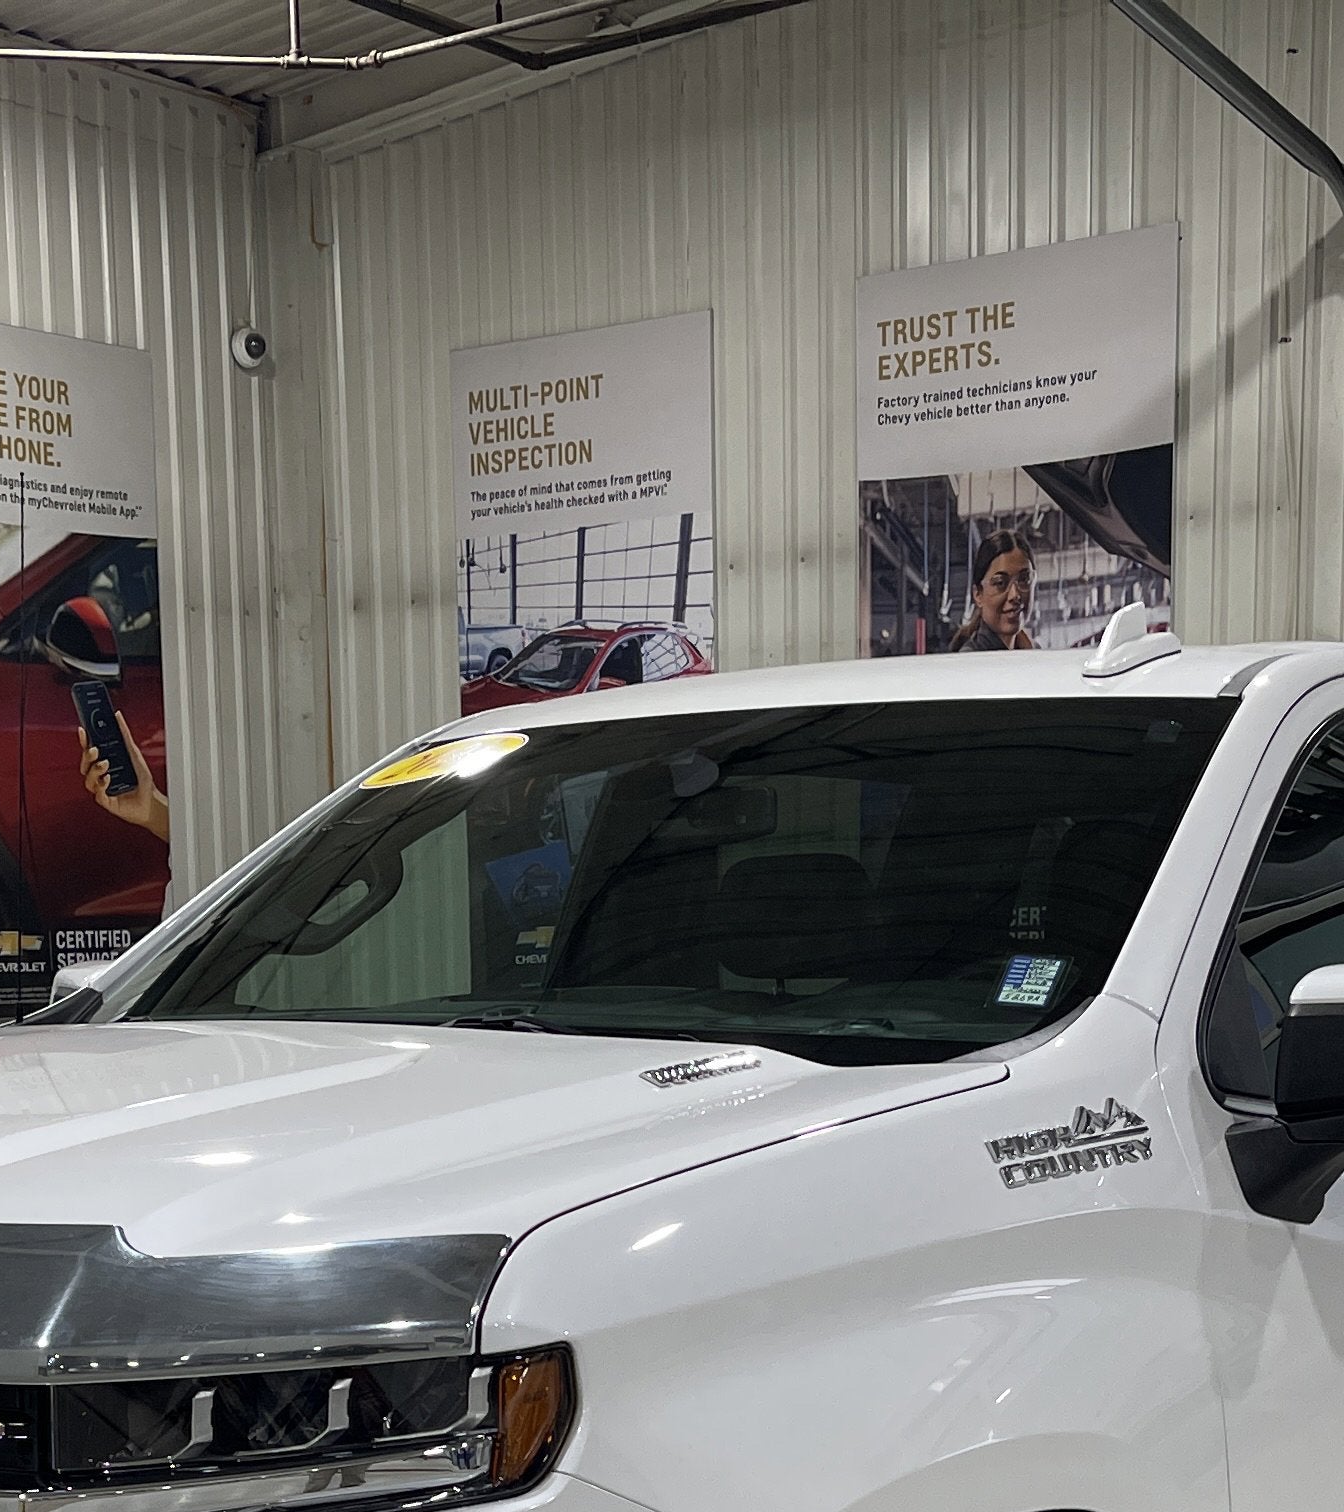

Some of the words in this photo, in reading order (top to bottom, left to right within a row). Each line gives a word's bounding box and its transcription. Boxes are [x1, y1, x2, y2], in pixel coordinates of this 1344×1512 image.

[876, 310, 958, 347] TRUST
[965, 301, 1016, 334] THE
[877, 340, 1001, 382] EXPERTS.
[13, 372, 70, 406] YOUR
[468, 373, 604, 415] MULTI-POINT
[877, 394, 920, 410] Factory
[922, 387, 964, 405] trained
[966, 378, 1033, 399] technicians
[1035, 374, 1067, 389] know
[1069, 368, 1098, 386] your
[15, 405, 73, 438] FROM
[877, 409, 911, 426] Chevy
[913, 405, 953, 423] vehicle
[956, 401, 992, 418] better
[994, 397, 1022, 413] than
[1023, 393, 1071, 409] anyone.
[468, 412, 555, 446] VEHICLE
[469, 438, 593, 478] INSPECTION
[50, 481, 68, 496] and
[69, 486, 94, 502] enjoy
[96, 489, 129, 503] remote
[470, 489, 487, 503] The
[489, 487, 516, 504] peace
[518, 486, 528, 498] of
[530, 482, 553, 497] mind
[555, 480, 575, 494] that
[577, 478, 608, 492] comes
[610, 473, 634, 487] from
[635, 468, 672, 487] getting
[27, 494, 87, 514] myChevrolet
[88, 502, 117, 516] Mobile
[470, 505, 492, 521] your
[493, 498, 532, 517] vehicle's
[534, 495, 564, 512] health
[566, 492, 605, 509] checked
[607, 489, 629, 503] with
[631, 490, 638, 500] a
[56, 929, 131, 949] CERTIFIED
[984, 1126, 1075, 1164] HIGH
[999, 1137, 1153, 1189] COUNTRY
